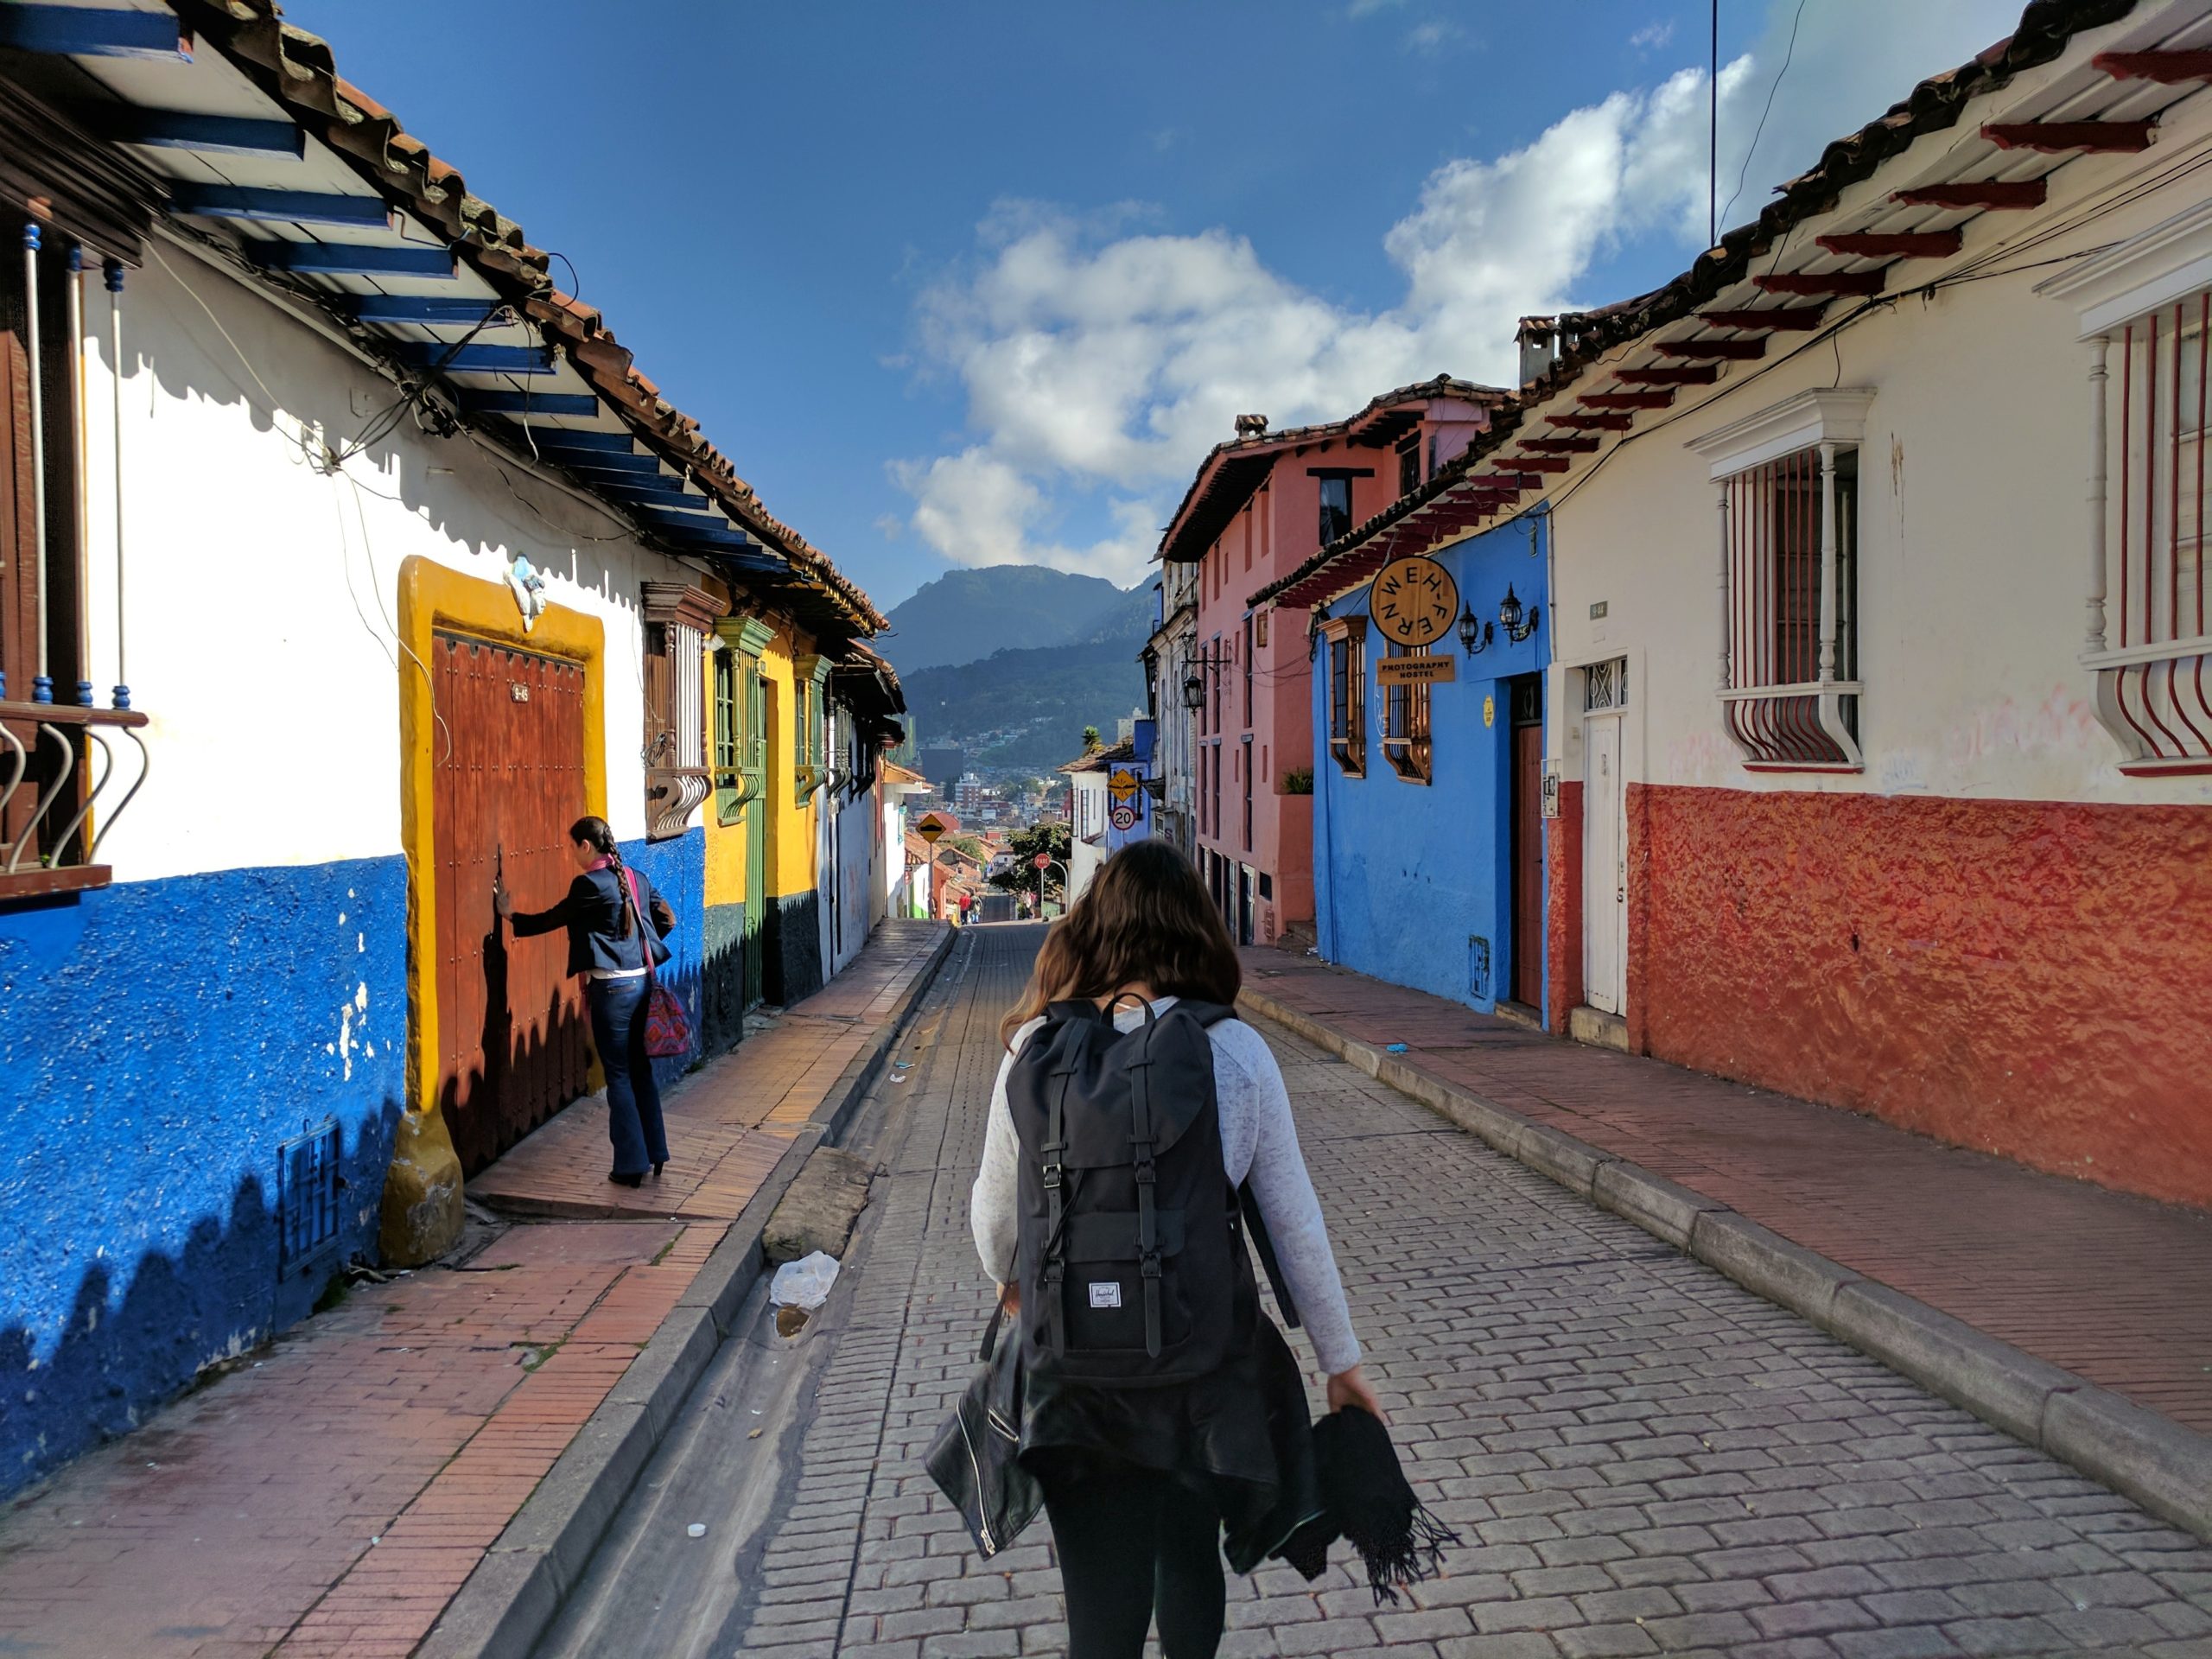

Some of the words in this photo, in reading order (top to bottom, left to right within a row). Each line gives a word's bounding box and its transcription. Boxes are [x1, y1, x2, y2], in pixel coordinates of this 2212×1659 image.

[1382, 662, 1450, 671] PHOTOGRAPHY
[515, 687, 528, 702] 9-45
[1116, 812, 1131, 823] 20
